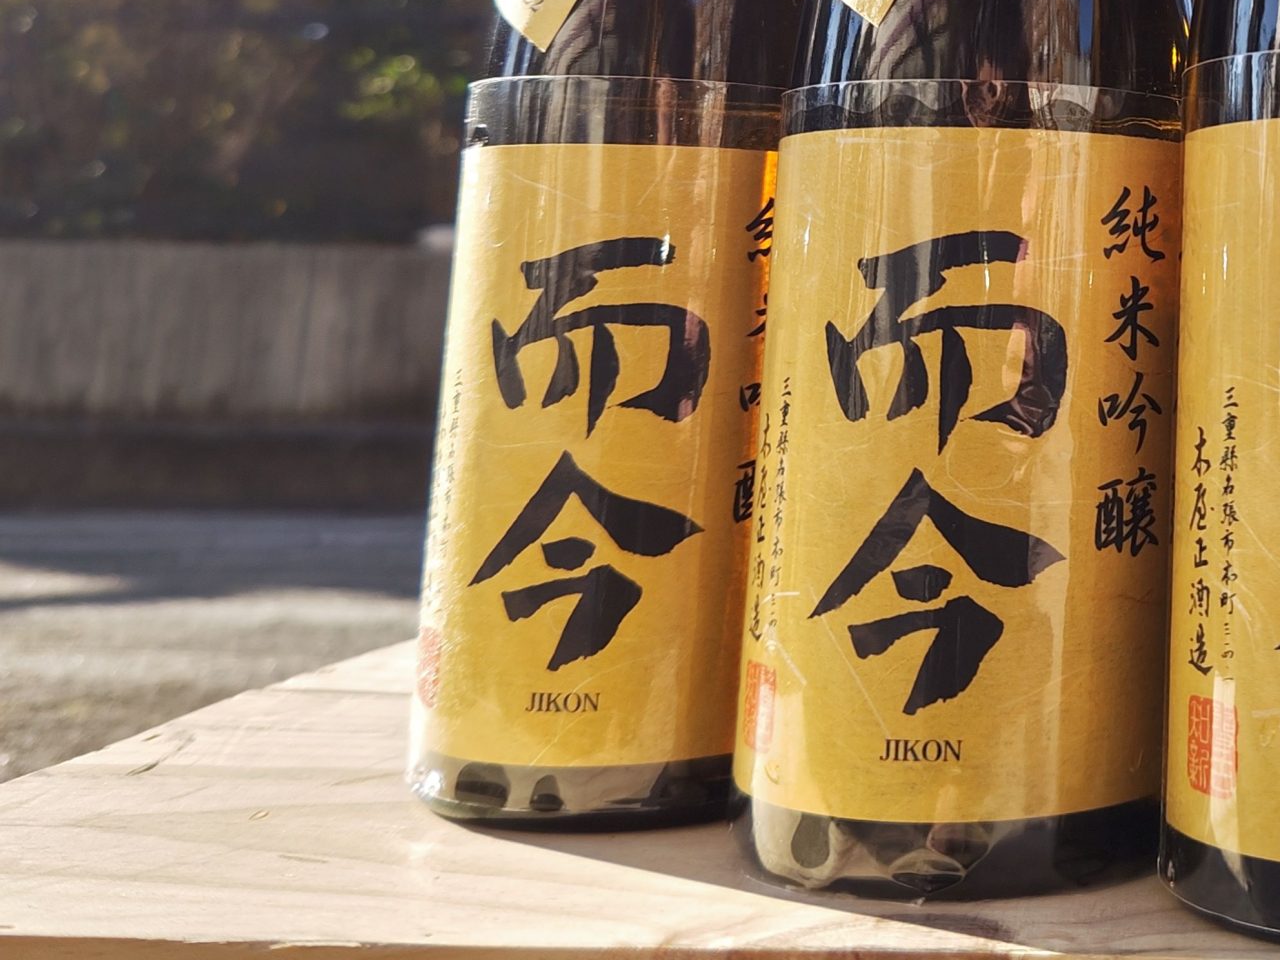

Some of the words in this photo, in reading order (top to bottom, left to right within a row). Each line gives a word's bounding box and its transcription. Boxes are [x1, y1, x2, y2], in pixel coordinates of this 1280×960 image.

[467, 236, 712, 672] 而今
[807, 230, 1068, 716] 而今
[525, 691, 601, 713] JIKON
[879, 737, 963, 762] JIKON
